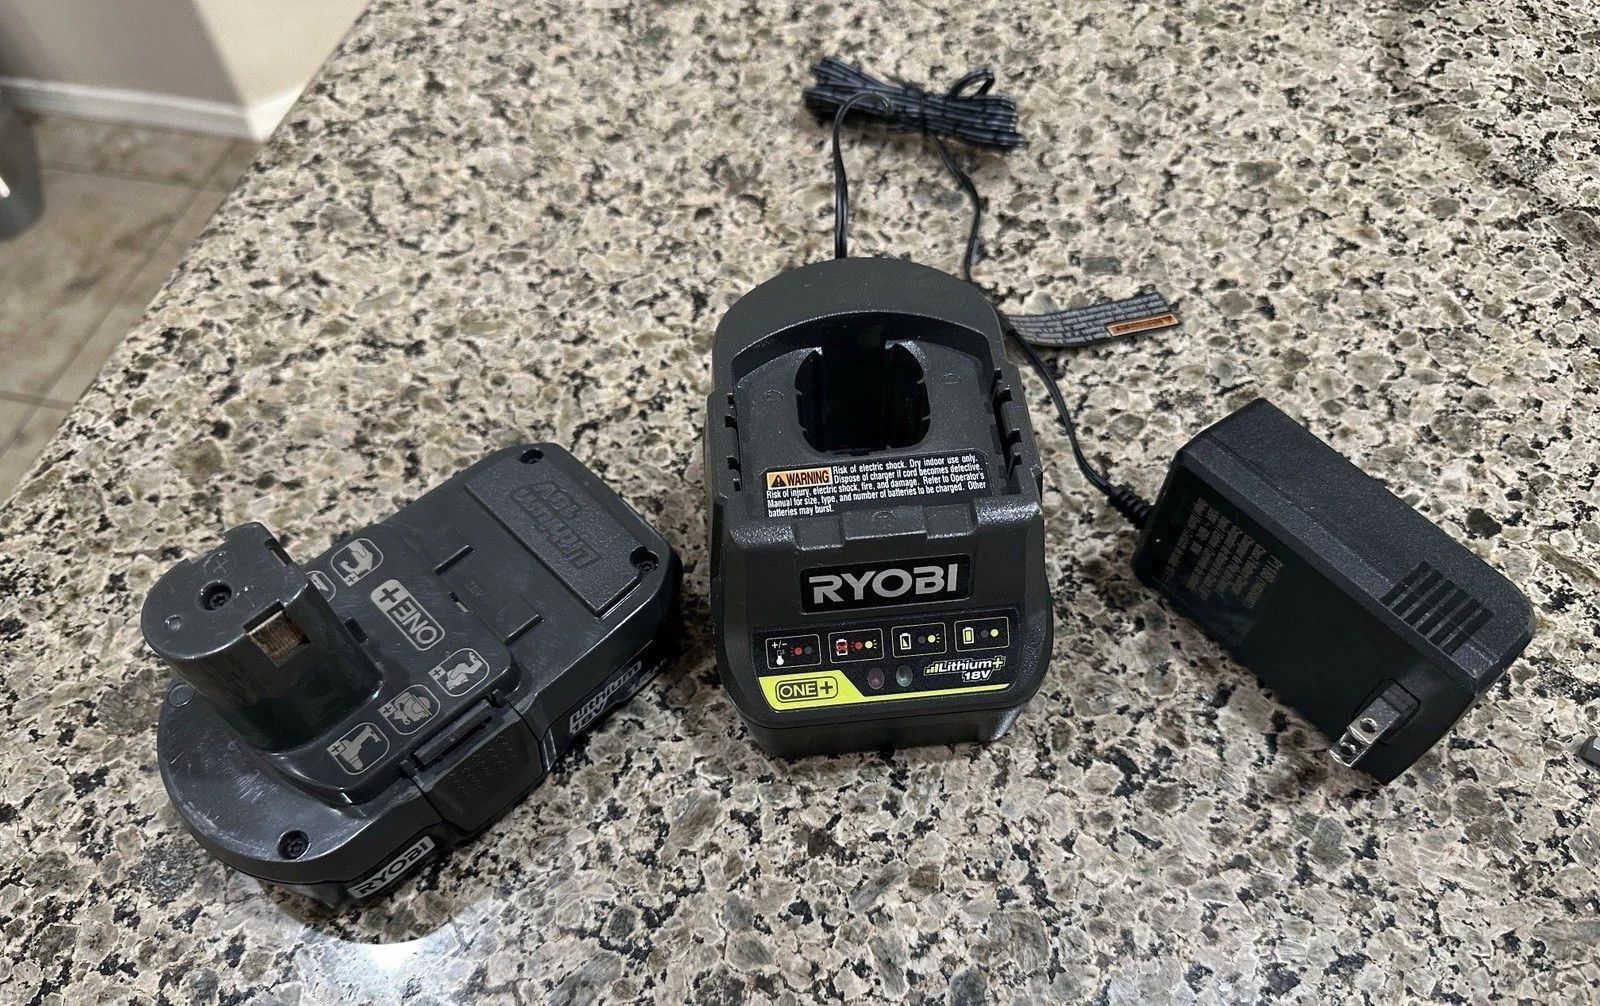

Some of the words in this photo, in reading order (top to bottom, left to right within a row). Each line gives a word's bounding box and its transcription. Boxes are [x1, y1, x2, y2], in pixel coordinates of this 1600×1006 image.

[833, 466, 847, 474] Risk
[859, 463, 883, 471] electric
[886, 461, 907, 470] shock.
[909, 459, 920, 468] Dry
[923, 457, 944, 466] indoor
[947, 456, 959, 464] use
[962, 454, 978, 462] only.
[834, 474, 860, 484] Dispose
[862, 473, 869, 481] of
[870, 471, 895, 481] charger
[903, 468, 917, 477] cord
[919, 467, 948, 476] becomes
[950, 463, 982, 473] defective.
[767, 490, 781, 499] Risk
[783, 489, 789, 497] of
[791, 488, 811, 497] injury,
[813, 486, 837, 495] electric
[839, 483, 860, 492] shock,
[862, 481, 875, 490] fire,
[891, 479, 919, 488] damage.
[923, 476, 940, 484] Refer
[950, 472, 984, 482] Operator's
[786, 470, 829, 486] WARNING
[768, 500, 792, 508] Manual
[794, 498, 803, 506] for
[805, 497, 819, 505] size,
[821, 496, 837, 505] type,
[853, 491, 878, 500] number
[881, 490, 886, 498] of
[888, 487, 917, 497] batteries
[918, 486, 924, 494] to
[926, 485, 934, 493] be
[936, 483, 964, 493] charged.
[968, 481, 986, 490] Other
[768, 507, 798, 517] batteries
[799, 507, 813, 515] may
[815, 504, 834, 513] burst.
[809, 563, 958, 604] RYOBI
[379, 588, 437, 644] ONE+
[965, 670, 991, 680] 18V
[570, 660, 642, 724] Lithium
[779, 681, 833, 698] ONE+
[354, 841, 429, 894] RYOBI
